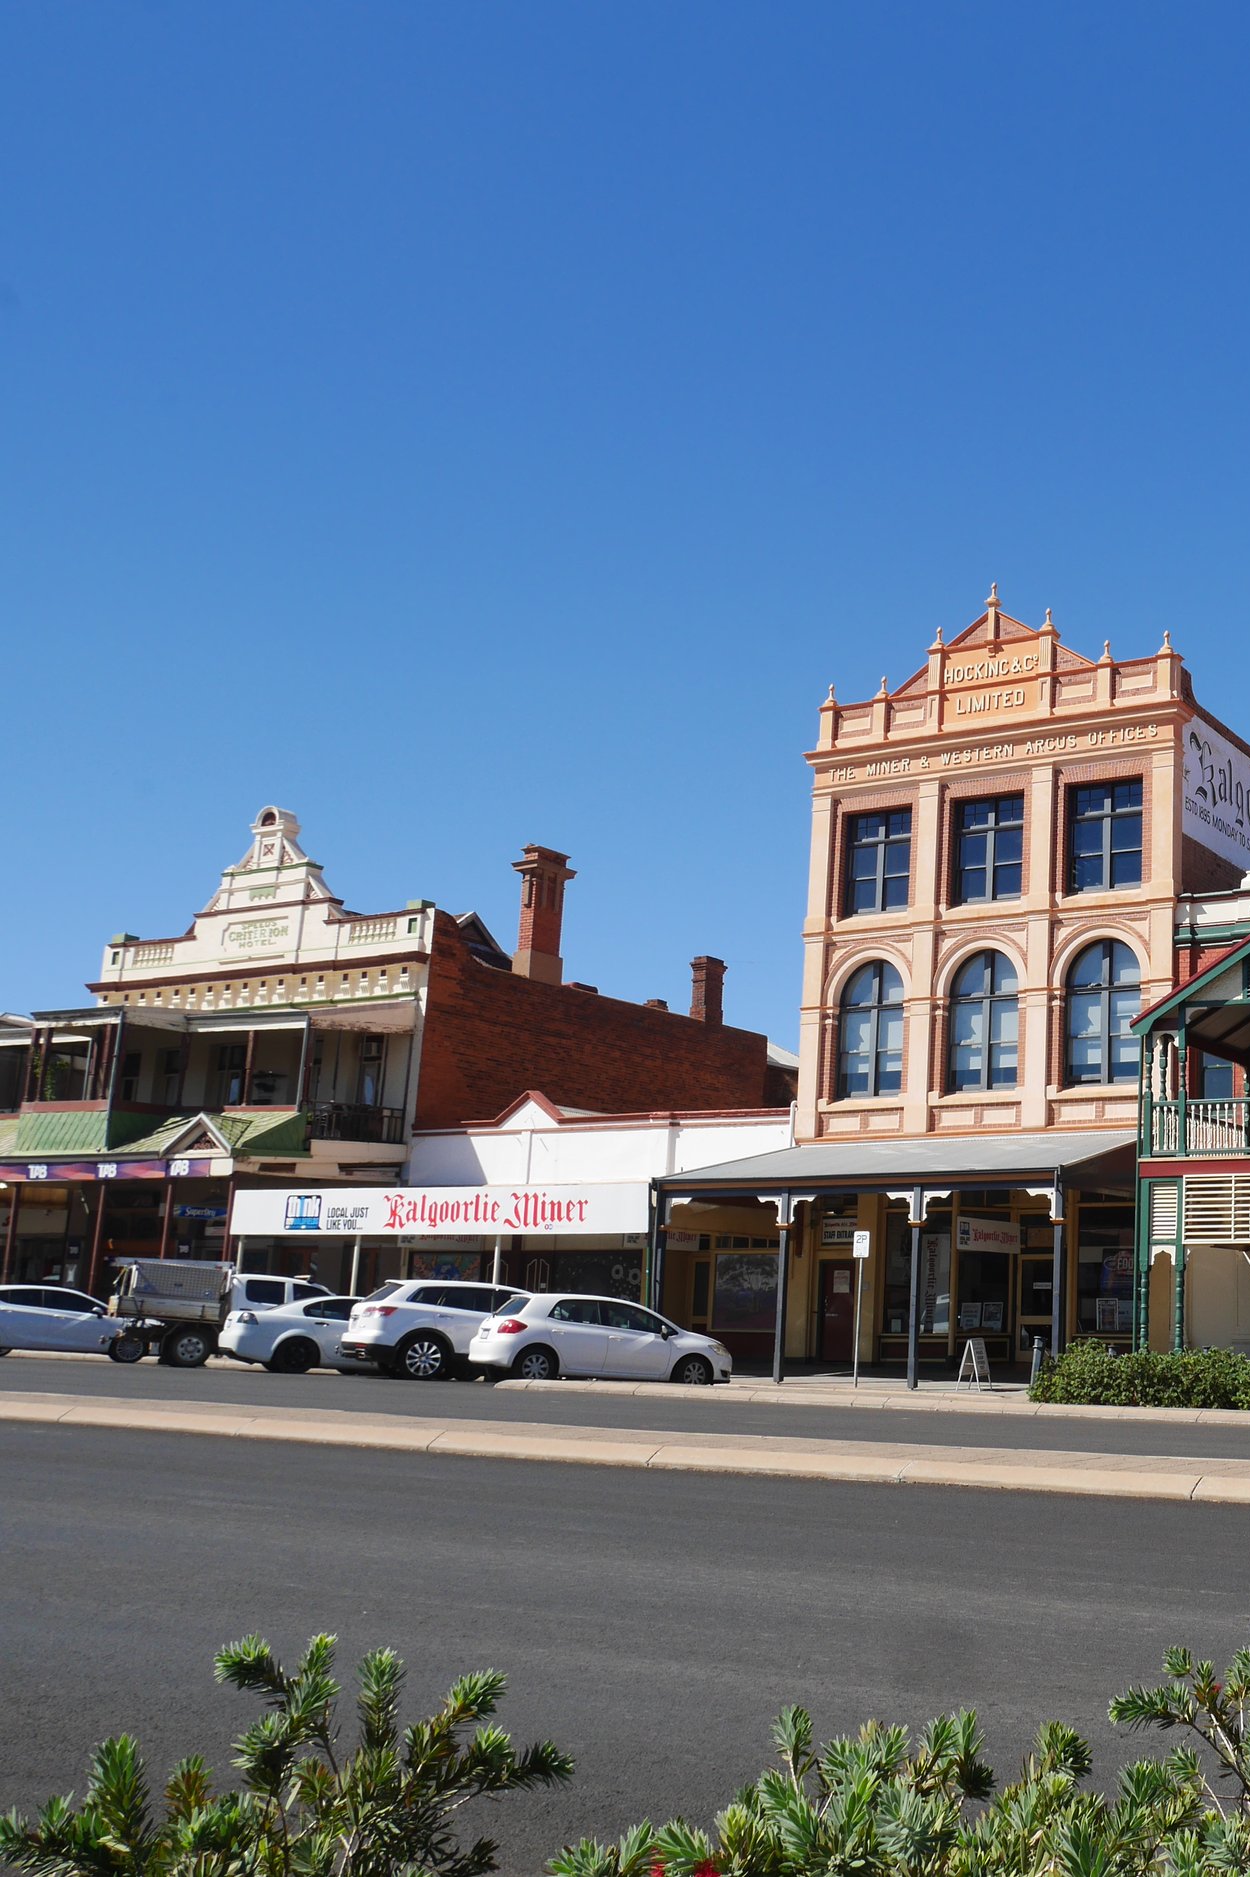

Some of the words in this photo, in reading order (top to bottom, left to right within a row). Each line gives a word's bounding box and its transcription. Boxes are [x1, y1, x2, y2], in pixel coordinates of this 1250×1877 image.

[957, 689, 1025, 715] LIMITED
[829, 766, 855, 782] THE
[867, 758, 910, 776] MINER
[920, 756, 930, 768] &
[941, 744, 1015, 765] WESTERN
[1088, 725, 1157, 745] OFFICES
[1199, 806, 1211, 825] 1895
[1212, 815, 1239, 842] MONDAY
[1239, 831, 1246, 846] TO
[229, 926, 288, 942] CRITERION
[28, 1164, 47, 1179] TAB
[97, 1164, 117, 1177] TAB
[169, 1160, 189, 1175] TAB
[327, 1207, 348, 1218] LOCAL
[350, 1207, 369, 1218] JUST
[384, 1194, 500, 1229] Kalgoorlie
[503, 1192, 589, 1229] Miner
[326, 1219, 341, 1230] LIKE
[856, 1235, 867, 1243] 2P
